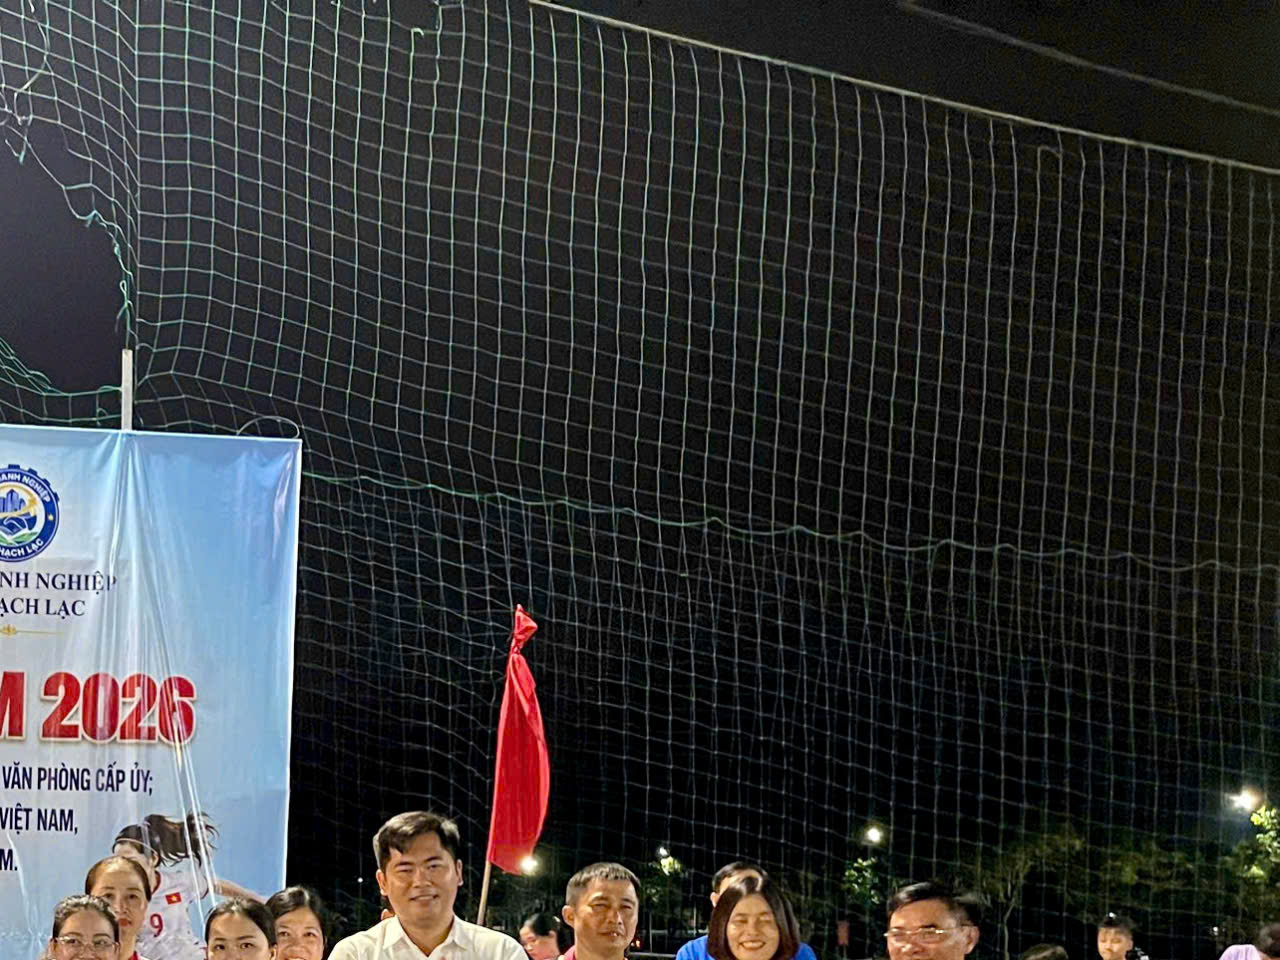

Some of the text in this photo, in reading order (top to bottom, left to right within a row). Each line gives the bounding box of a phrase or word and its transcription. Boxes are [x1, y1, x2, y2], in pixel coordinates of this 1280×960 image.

[36, 571, 117, 595] NGHIỆP
[46, 599, 87, 619] LẠC
[40, 671, 197, 745] 2026
[2, 761, 32, 790] VĂN
[37, 762, 91, 792] PHÒNG
[95, 761, 126, 792] CẤP
[130, 762, 153, 796] ỦY;
[0, 803, 32, 835] VIỆT
[37, 808, 78, 835] NAM,
[150, 913, 163, 938] 9
